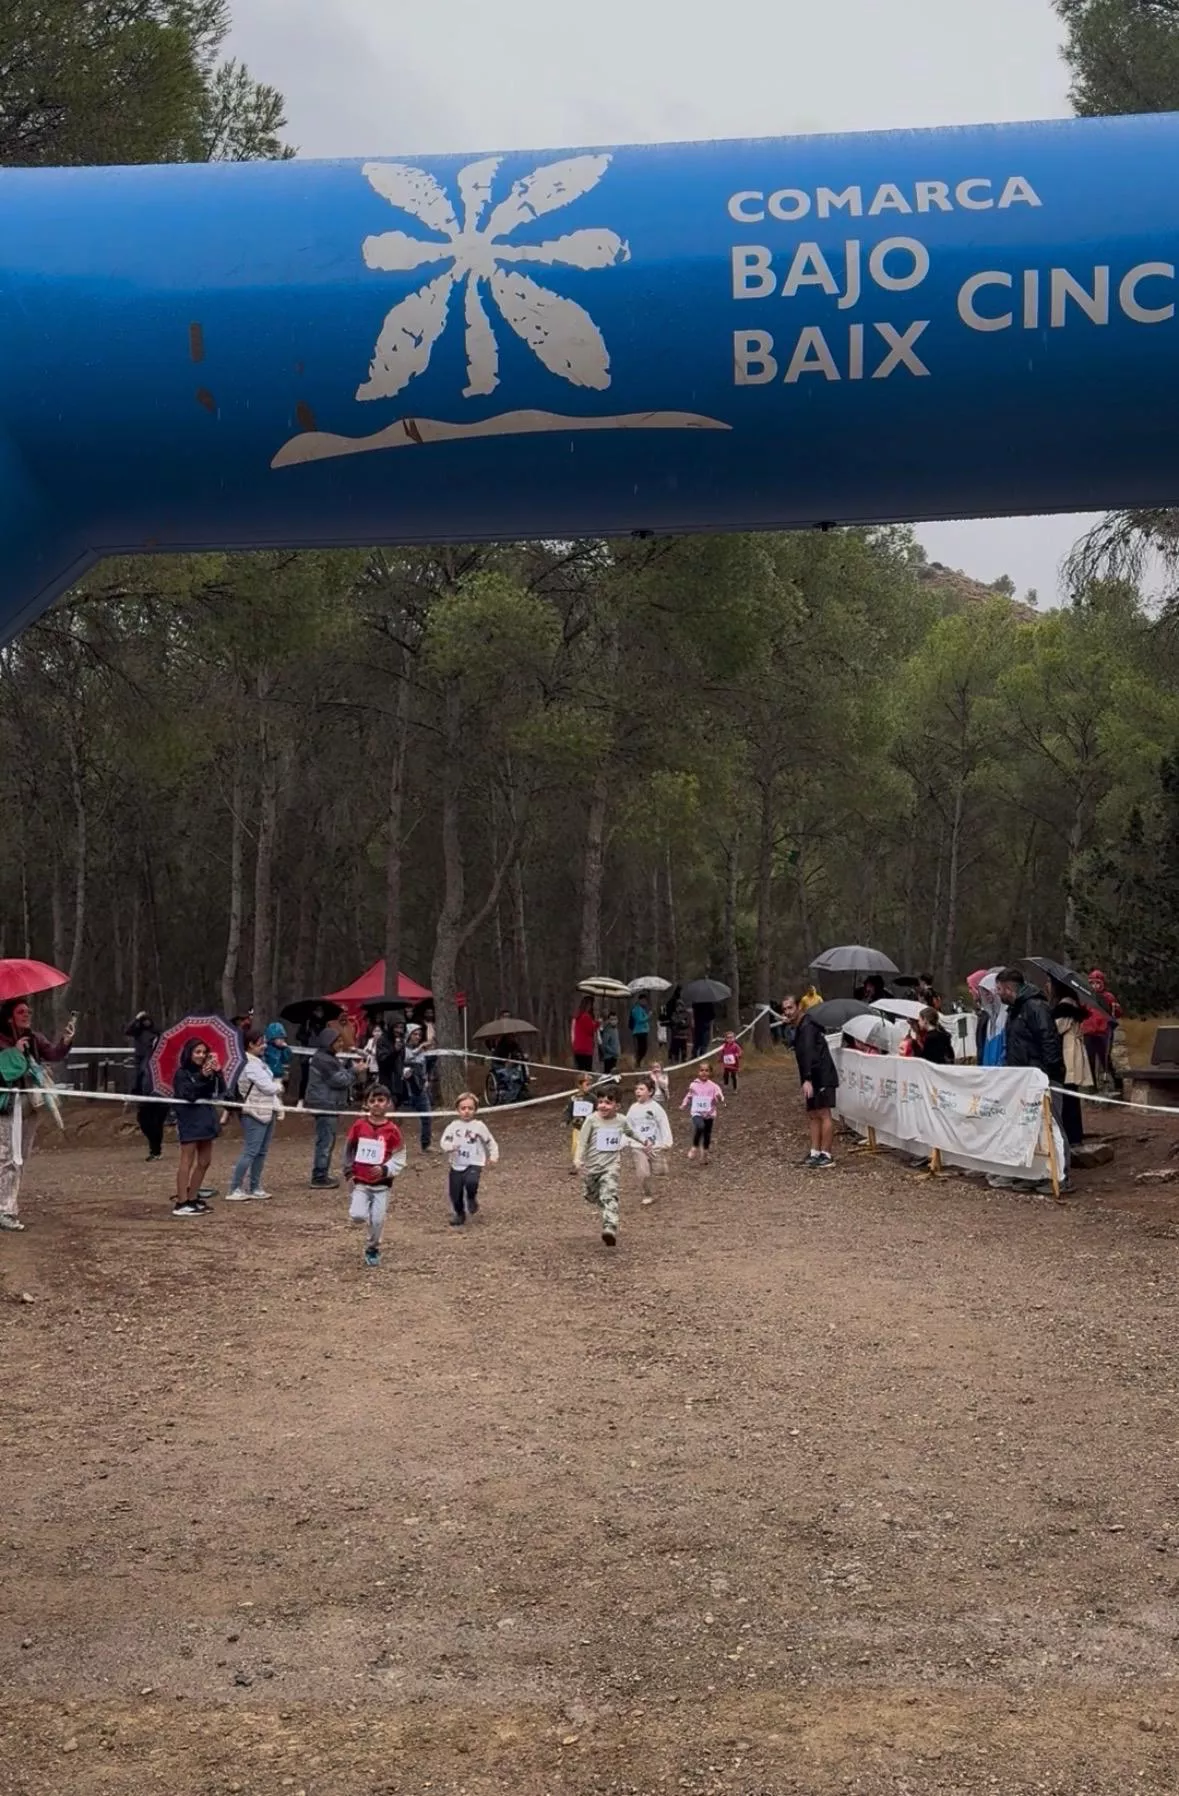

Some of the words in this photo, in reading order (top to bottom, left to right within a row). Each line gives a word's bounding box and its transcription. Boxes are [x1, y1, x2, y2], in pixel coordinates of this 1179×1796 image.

[728, 177, 1043, 223] COMARCA
[731, 237, 930, 310] BAJO
[733, 320, 931, 386] BAIX
